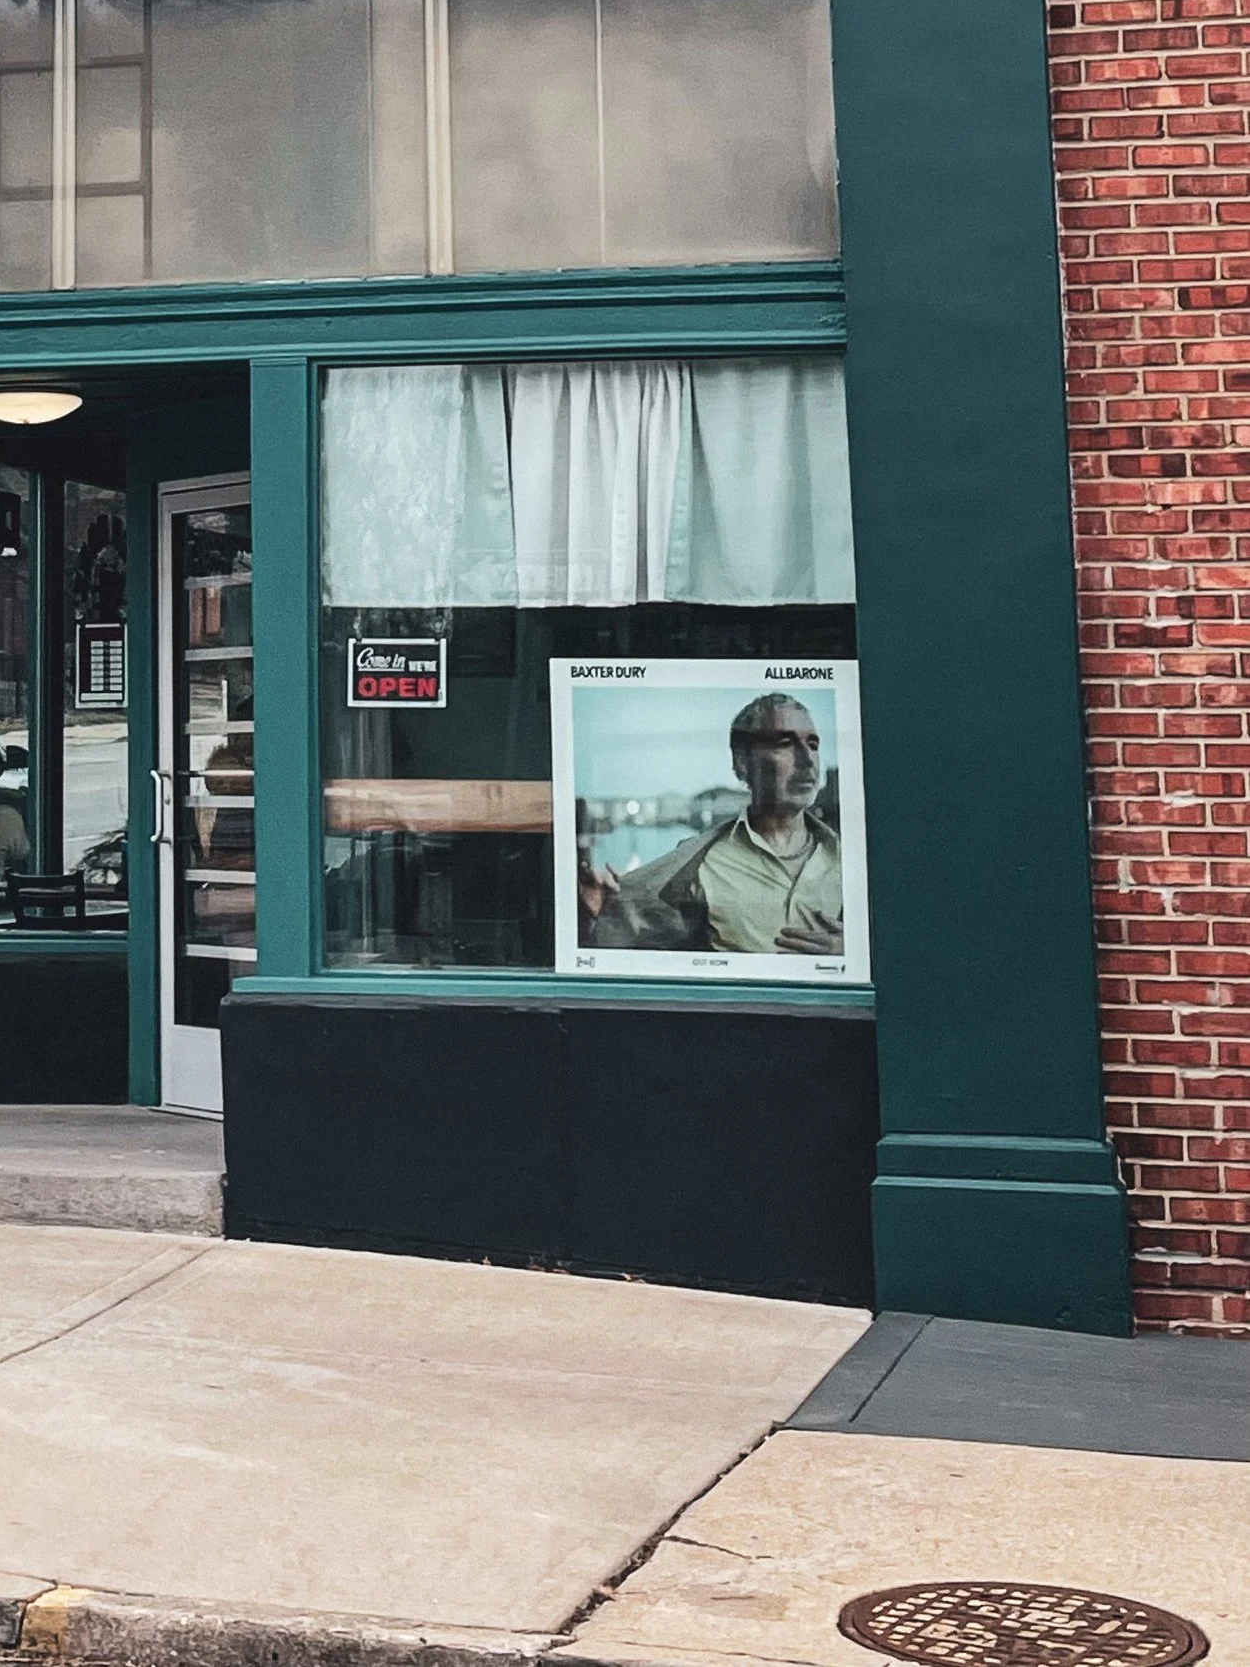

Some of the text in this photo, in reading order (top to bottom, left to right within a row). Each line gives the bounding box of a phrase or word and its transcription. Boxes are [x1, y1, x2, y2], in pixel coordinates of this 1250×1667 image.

[356, 647, 392, 668] Come
[392, 653, 406, 668] in
[570, 666, 646, 678] BAXTER DURY
[764, 667, 834, 680] ALLBARONE
[358, 677, 437, 697] OPEN
